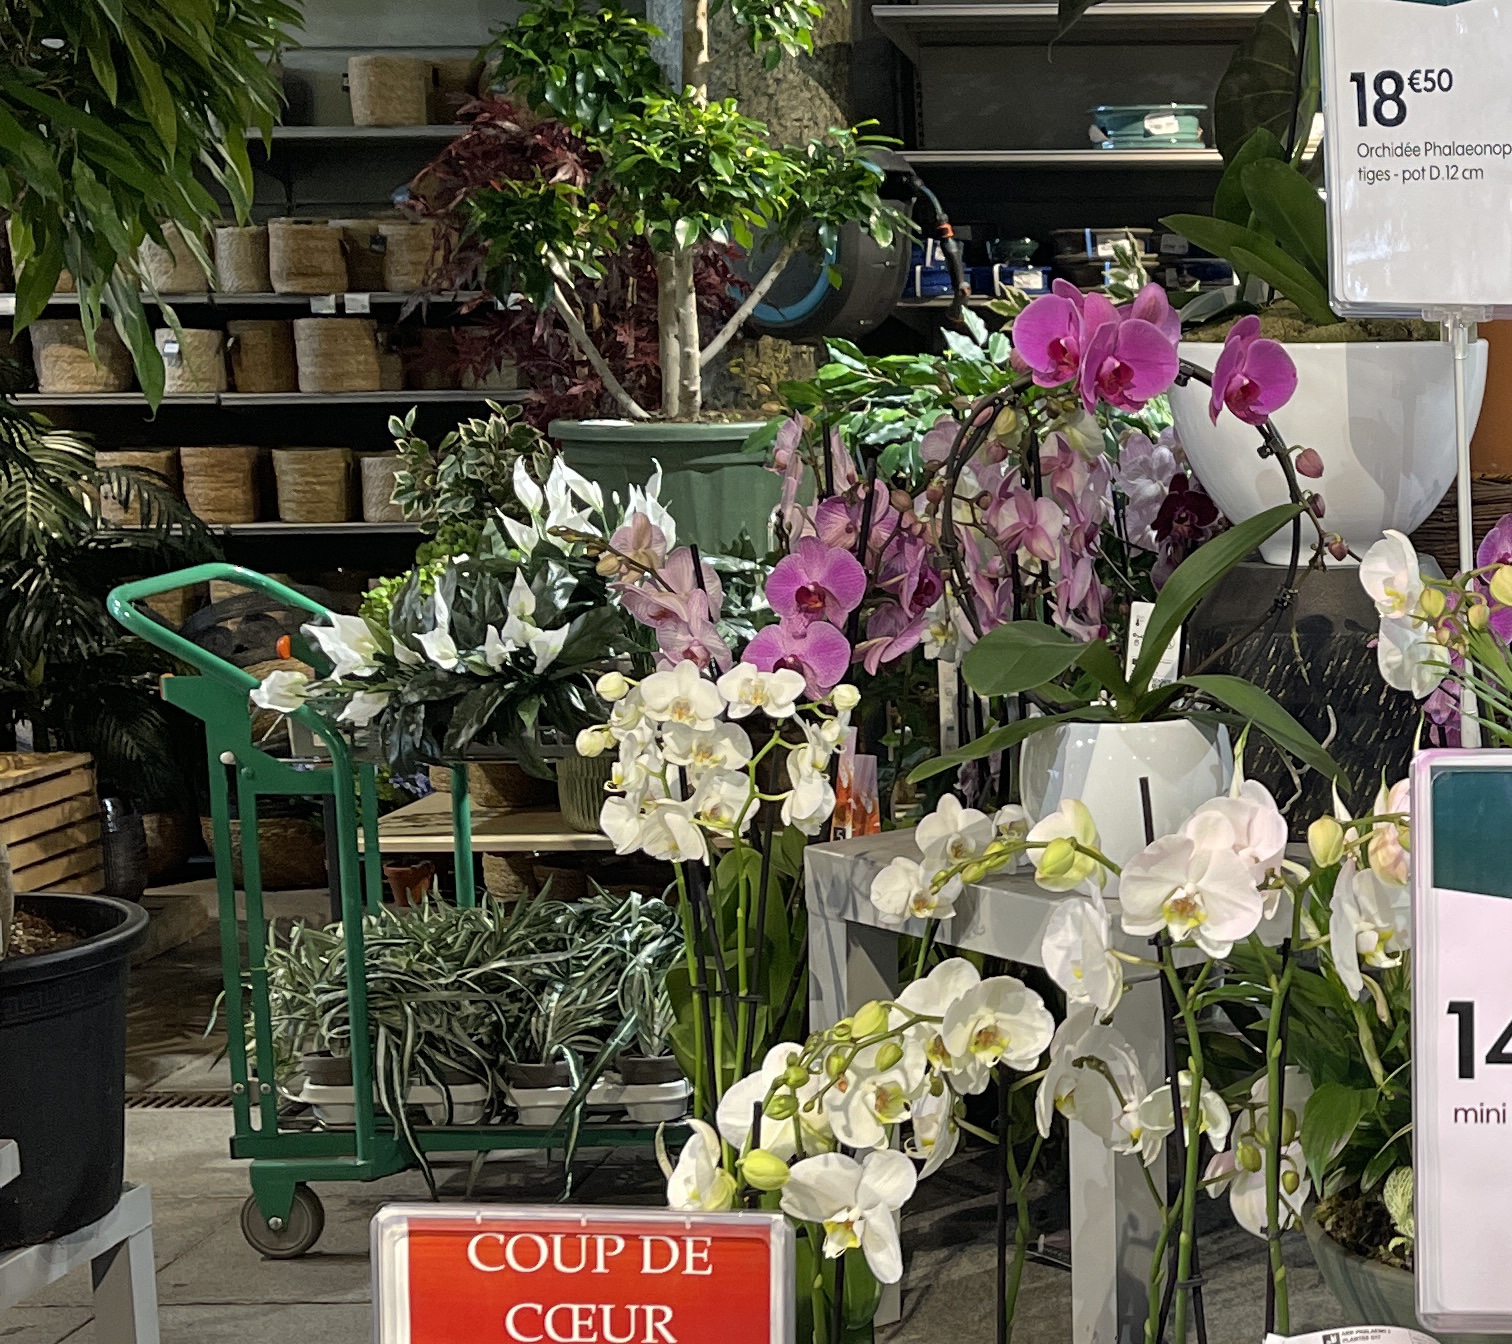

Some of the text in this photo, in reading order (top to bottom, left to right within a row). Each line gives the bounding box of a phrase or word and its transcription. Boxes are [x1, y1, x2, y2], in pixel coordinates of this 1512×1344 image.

[1357, 139, 1421, 159] Orchidée
[1358, 166, 1391, 186] tiges
[1402, 166, 1427, 186] pot
[1429, 165, 1459, 182] D.12
[1462, 167, 1484, 181] cm
[1453, 1101, 1506, 1126] mini
[467, 1234, 713, 1275] COUP DE
[505, 1302, 678, 1344] CŒUR
